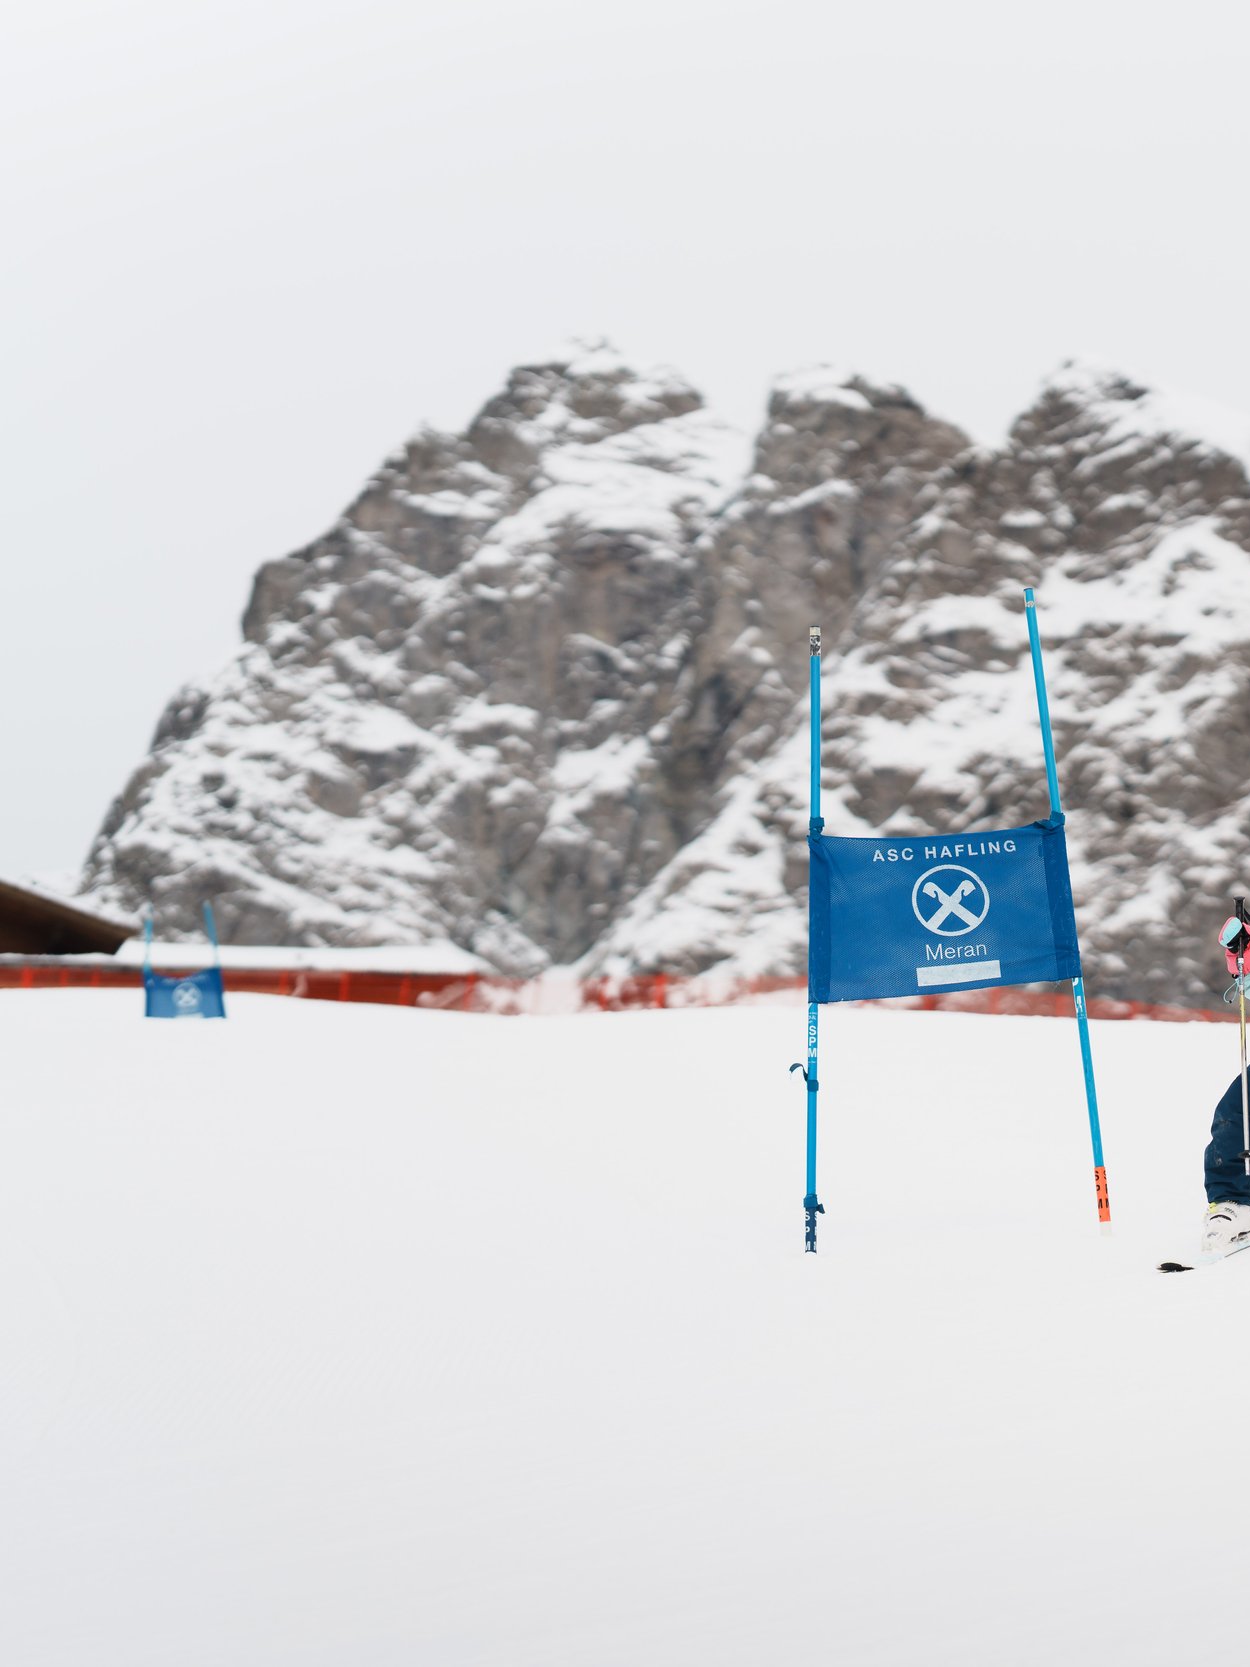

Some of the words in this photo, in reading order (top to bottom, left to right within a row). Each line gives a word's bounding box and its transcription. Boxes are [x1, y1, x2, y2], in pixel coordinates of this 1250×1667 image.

[872, 847, 914, 862] ASC
[925, 839, 1017, 860] HAFLING
[925, 942, 987, 961] Meran
[808, 1025, 817, 1058] SPM
